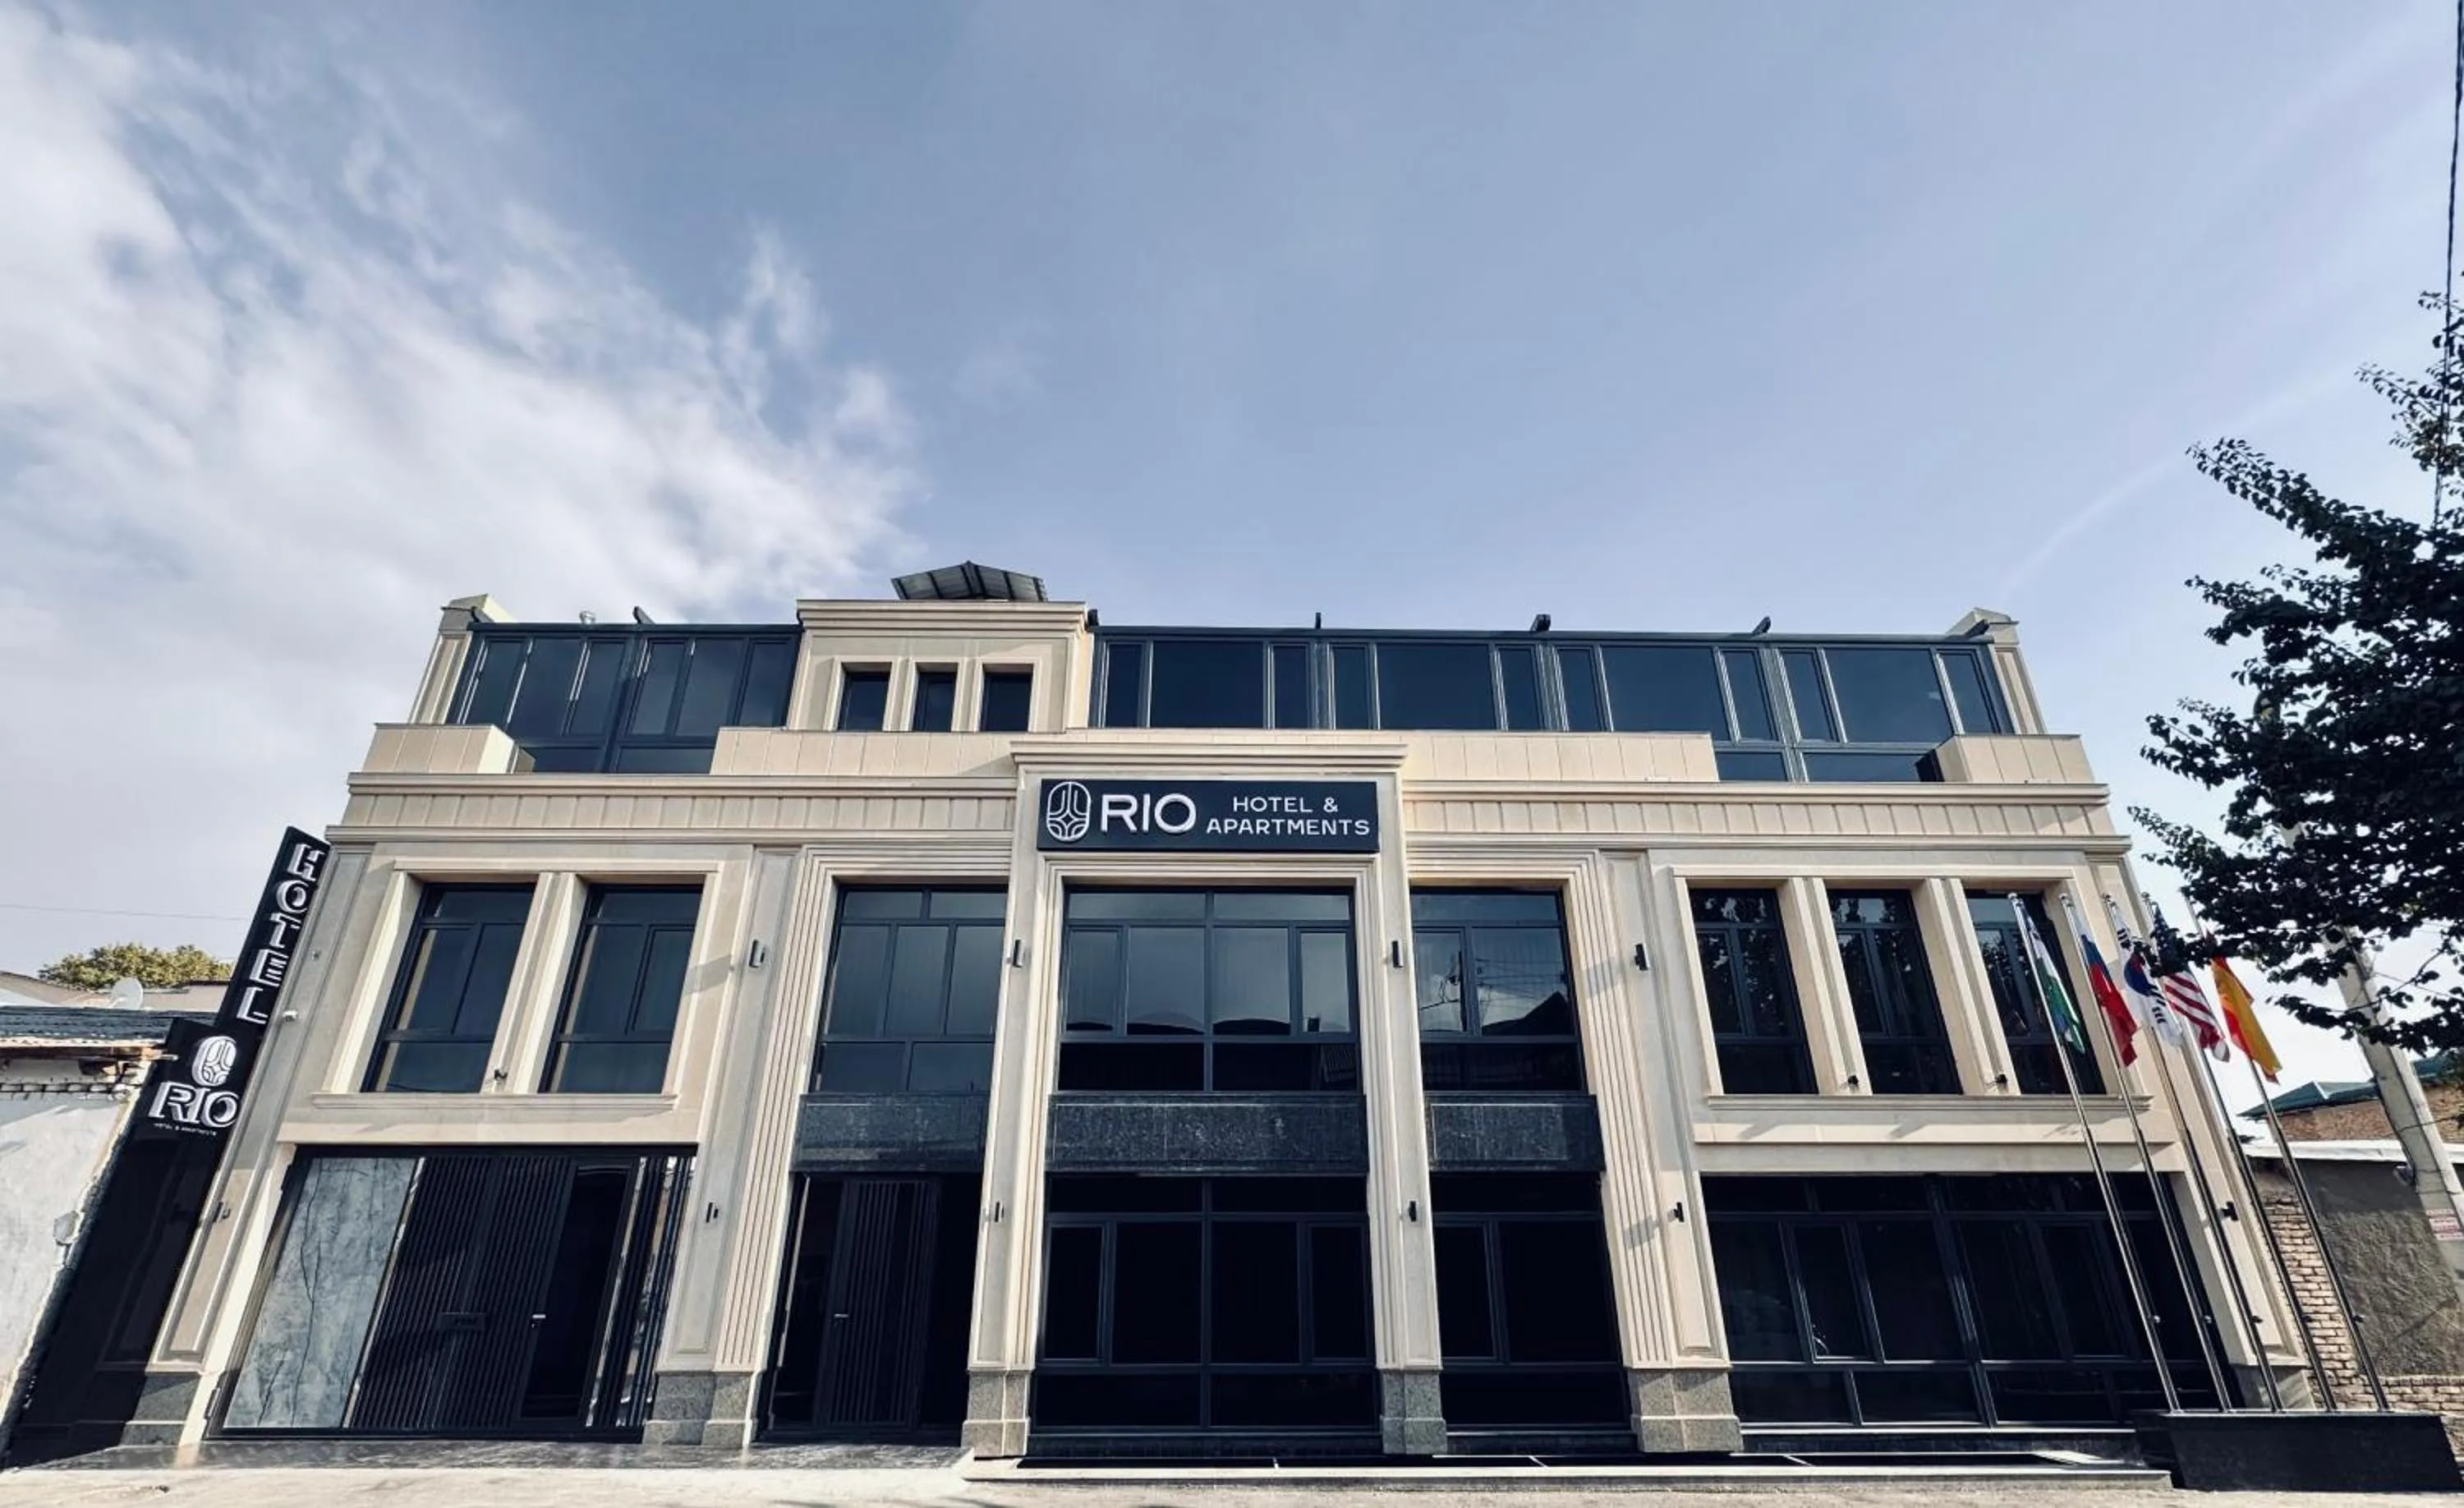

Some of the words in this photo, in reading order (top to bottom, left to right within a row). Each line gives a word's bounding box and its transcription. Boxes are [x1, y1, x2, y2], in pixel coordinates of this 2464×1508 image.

[1101, 793, 1197, 834] RIO
[1233, 797, 1313, 813] HOTEL
[1322, 797, 1339, 813] &
[1206, 818, 1370, 835] APARTMENTS
[237, 844, 325, 1024] HOTEL
[148, 1081, 240, 1128] RIO
